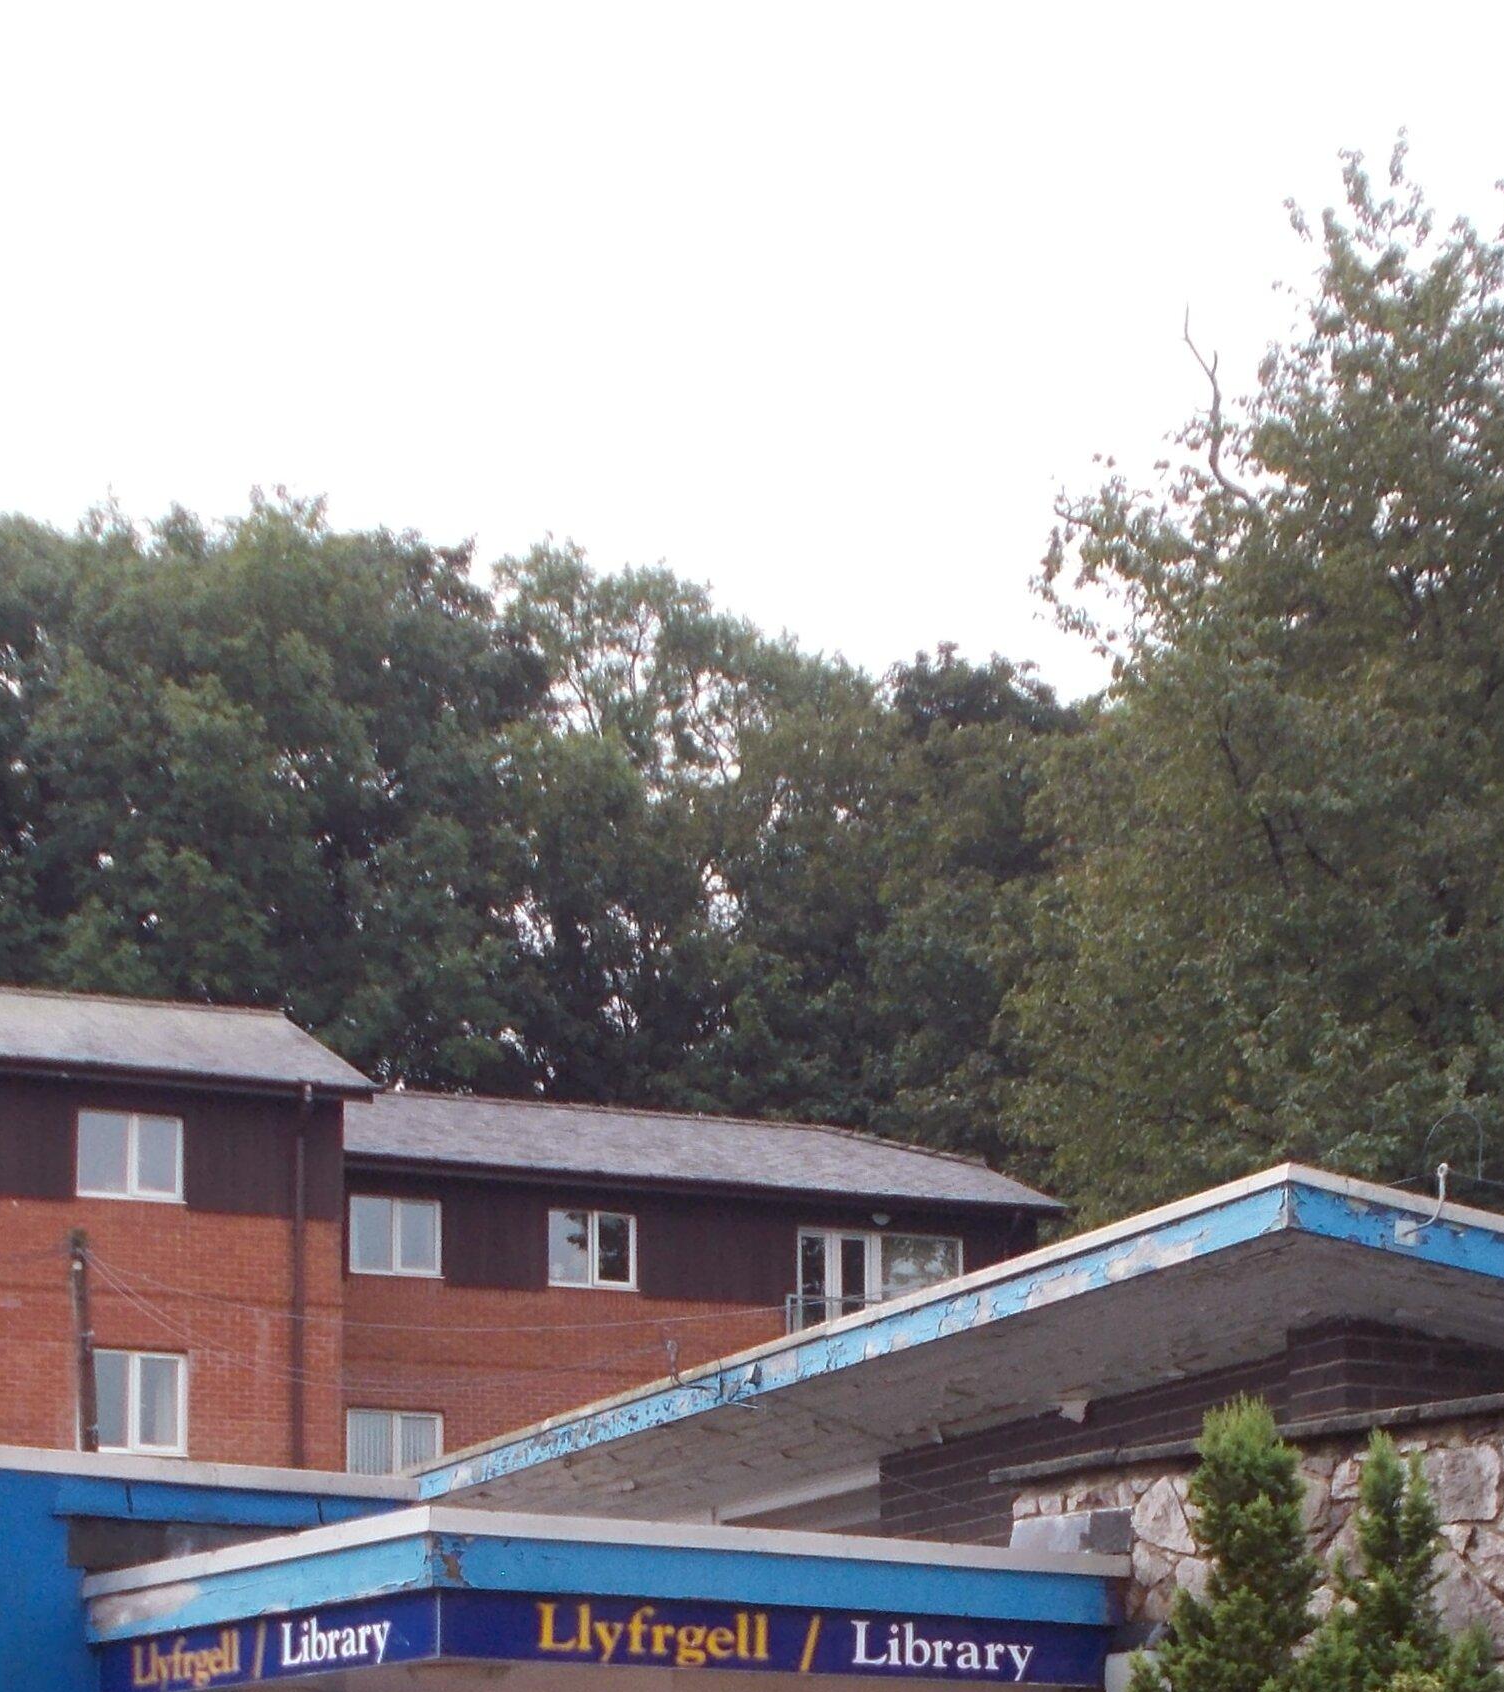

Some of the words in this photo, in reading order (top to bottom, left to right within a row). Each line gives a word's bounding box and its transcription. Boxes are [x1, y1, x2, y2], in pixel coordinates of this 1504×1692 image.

[133, 1627, 241, 1692] Llyfrgell
[253, 1619, 267, 1680] /
[281, 1615, 391, 1666] Library
[536, 1602, 770, 1667] Llyfrgell
[799, 1614, 821, 1672] /
[851, 1618, 1034, 1681] Library
